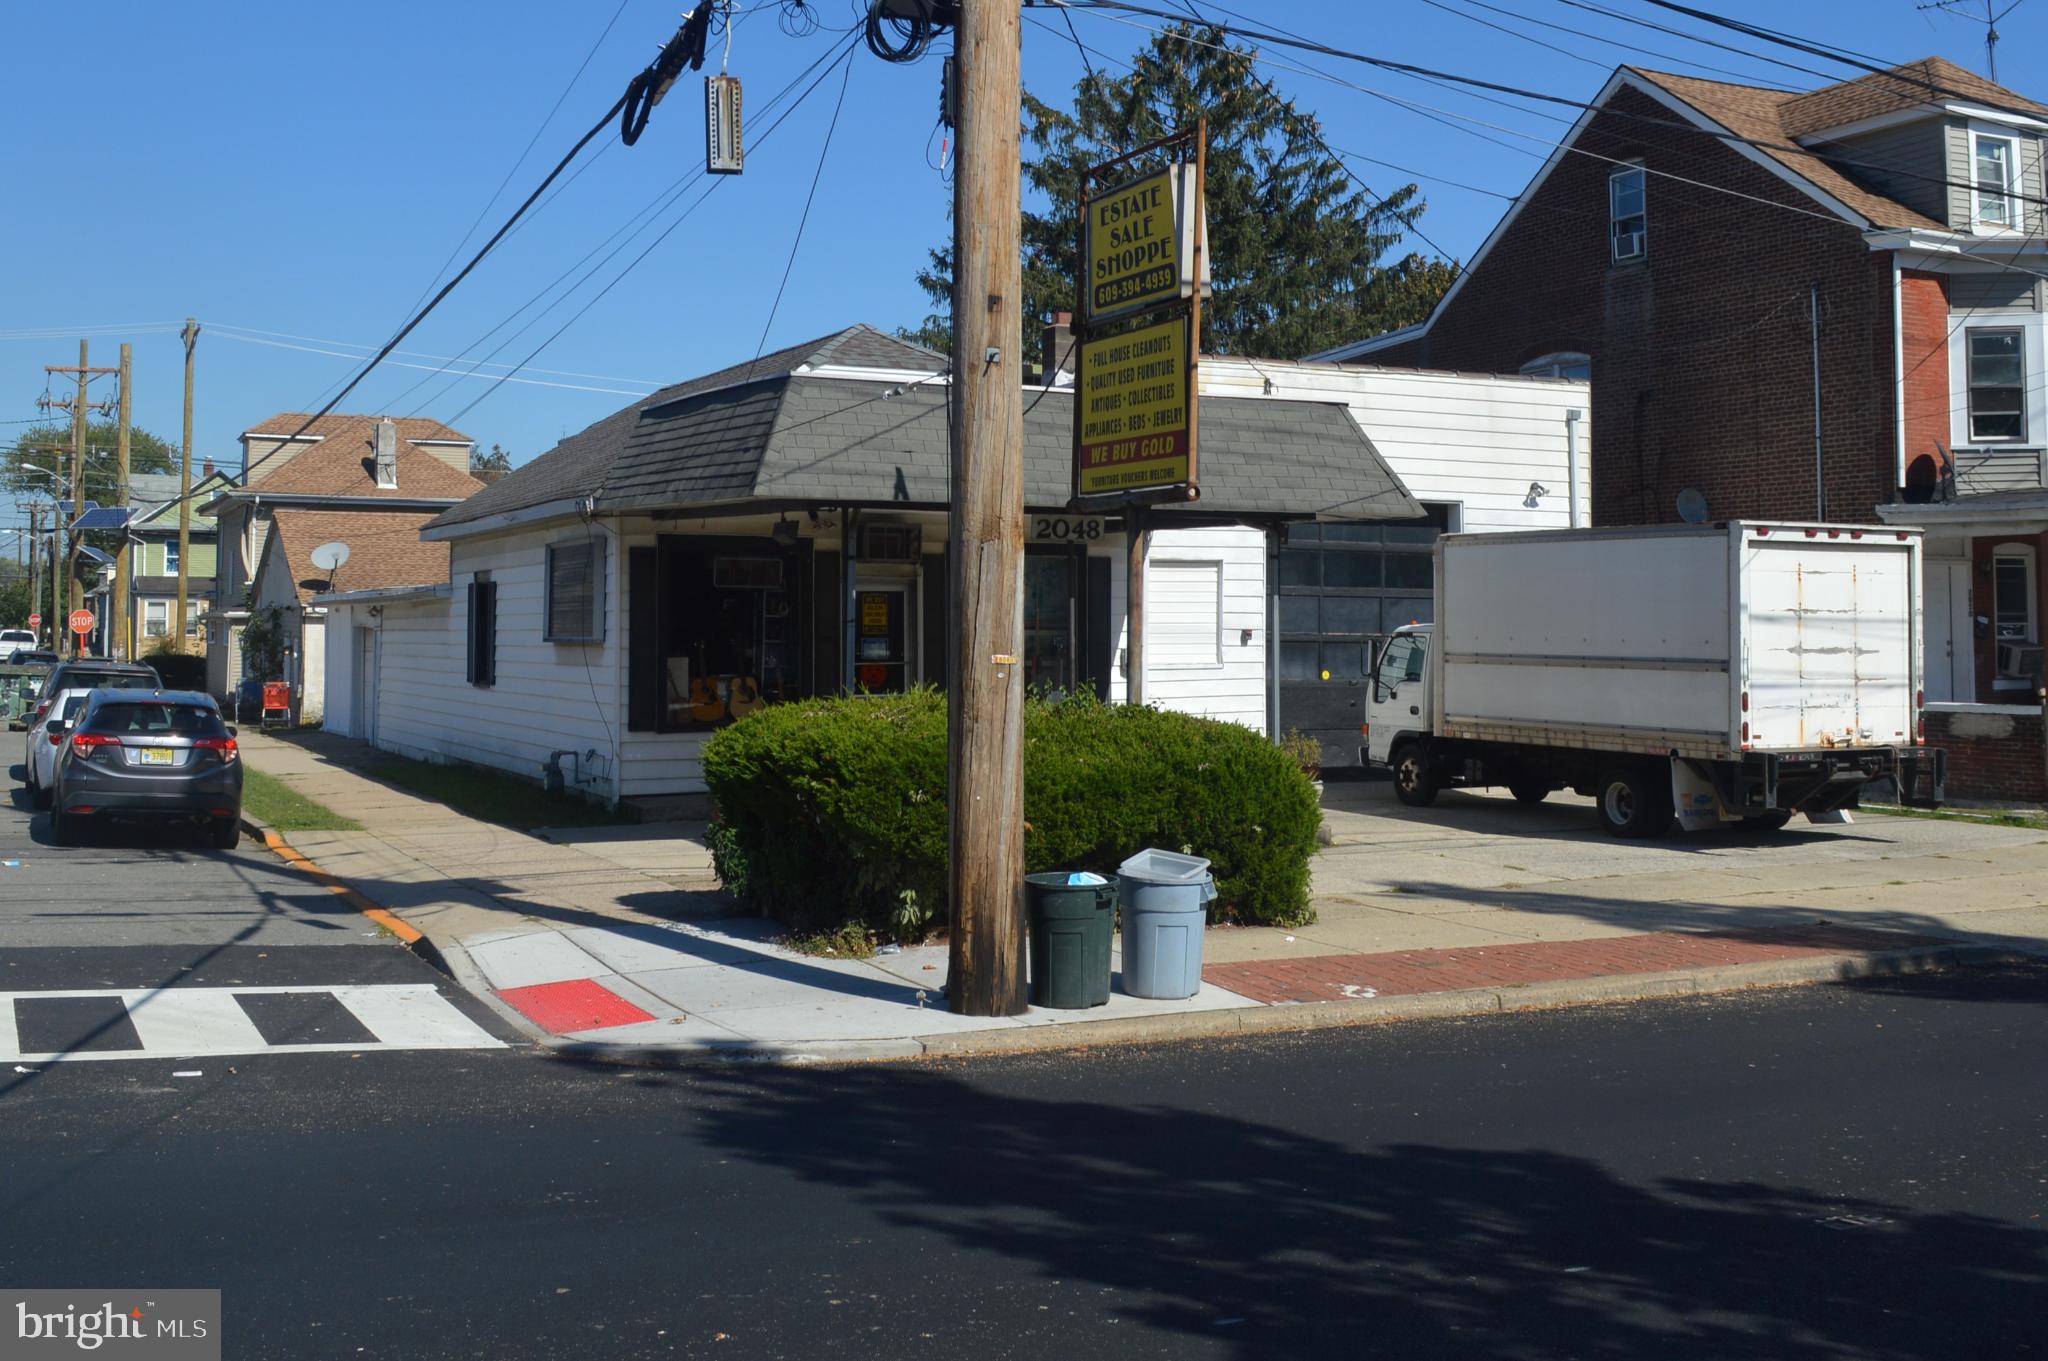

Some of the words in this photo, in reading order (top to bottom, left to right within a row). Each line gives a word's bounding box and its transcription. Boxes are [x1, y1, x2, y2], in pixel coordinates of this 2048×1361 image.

[1100, 185, 1161, 227] ESTATE
[1110, 216, 1153, 248] SALE
[1096, 237, 1171, 279] SHOPPE
[1098, 268, 1171, 304] 609-394-4939
[1093, 350, 1107, 367] FULL
[1109, 345, 1130, 364] HOUSE
[1133, 336, 1171, 358] CLEANOUTS
[1090, 372, 1116, 392] QUALITY
[1118, 366, 1135, 385] USED
[1137, 358, 1175, 380] FURNITURE
[1091, 393, 1121, 413] ANTIQUES
[1128, 384, 1175, 407] COLLECTIBLES
[1085, 418, 1122, 438] APPLIANCES
[1128, 414, 1146, 432] BEDS
[1153, 407, 1183, 428] JEWELRY
[1091, 446, 1108, 464] WE
[1112, 442, 1137, 461] BUY
[1141, 436, 1174, 456] GOLD
[1120, 470, 1148, 486] VOUCHERS
[1149, 467, 1175, 482] WELCOME
[1036, 519, 1100, 539] 2048
[71, 617, 93, 626] STOP
